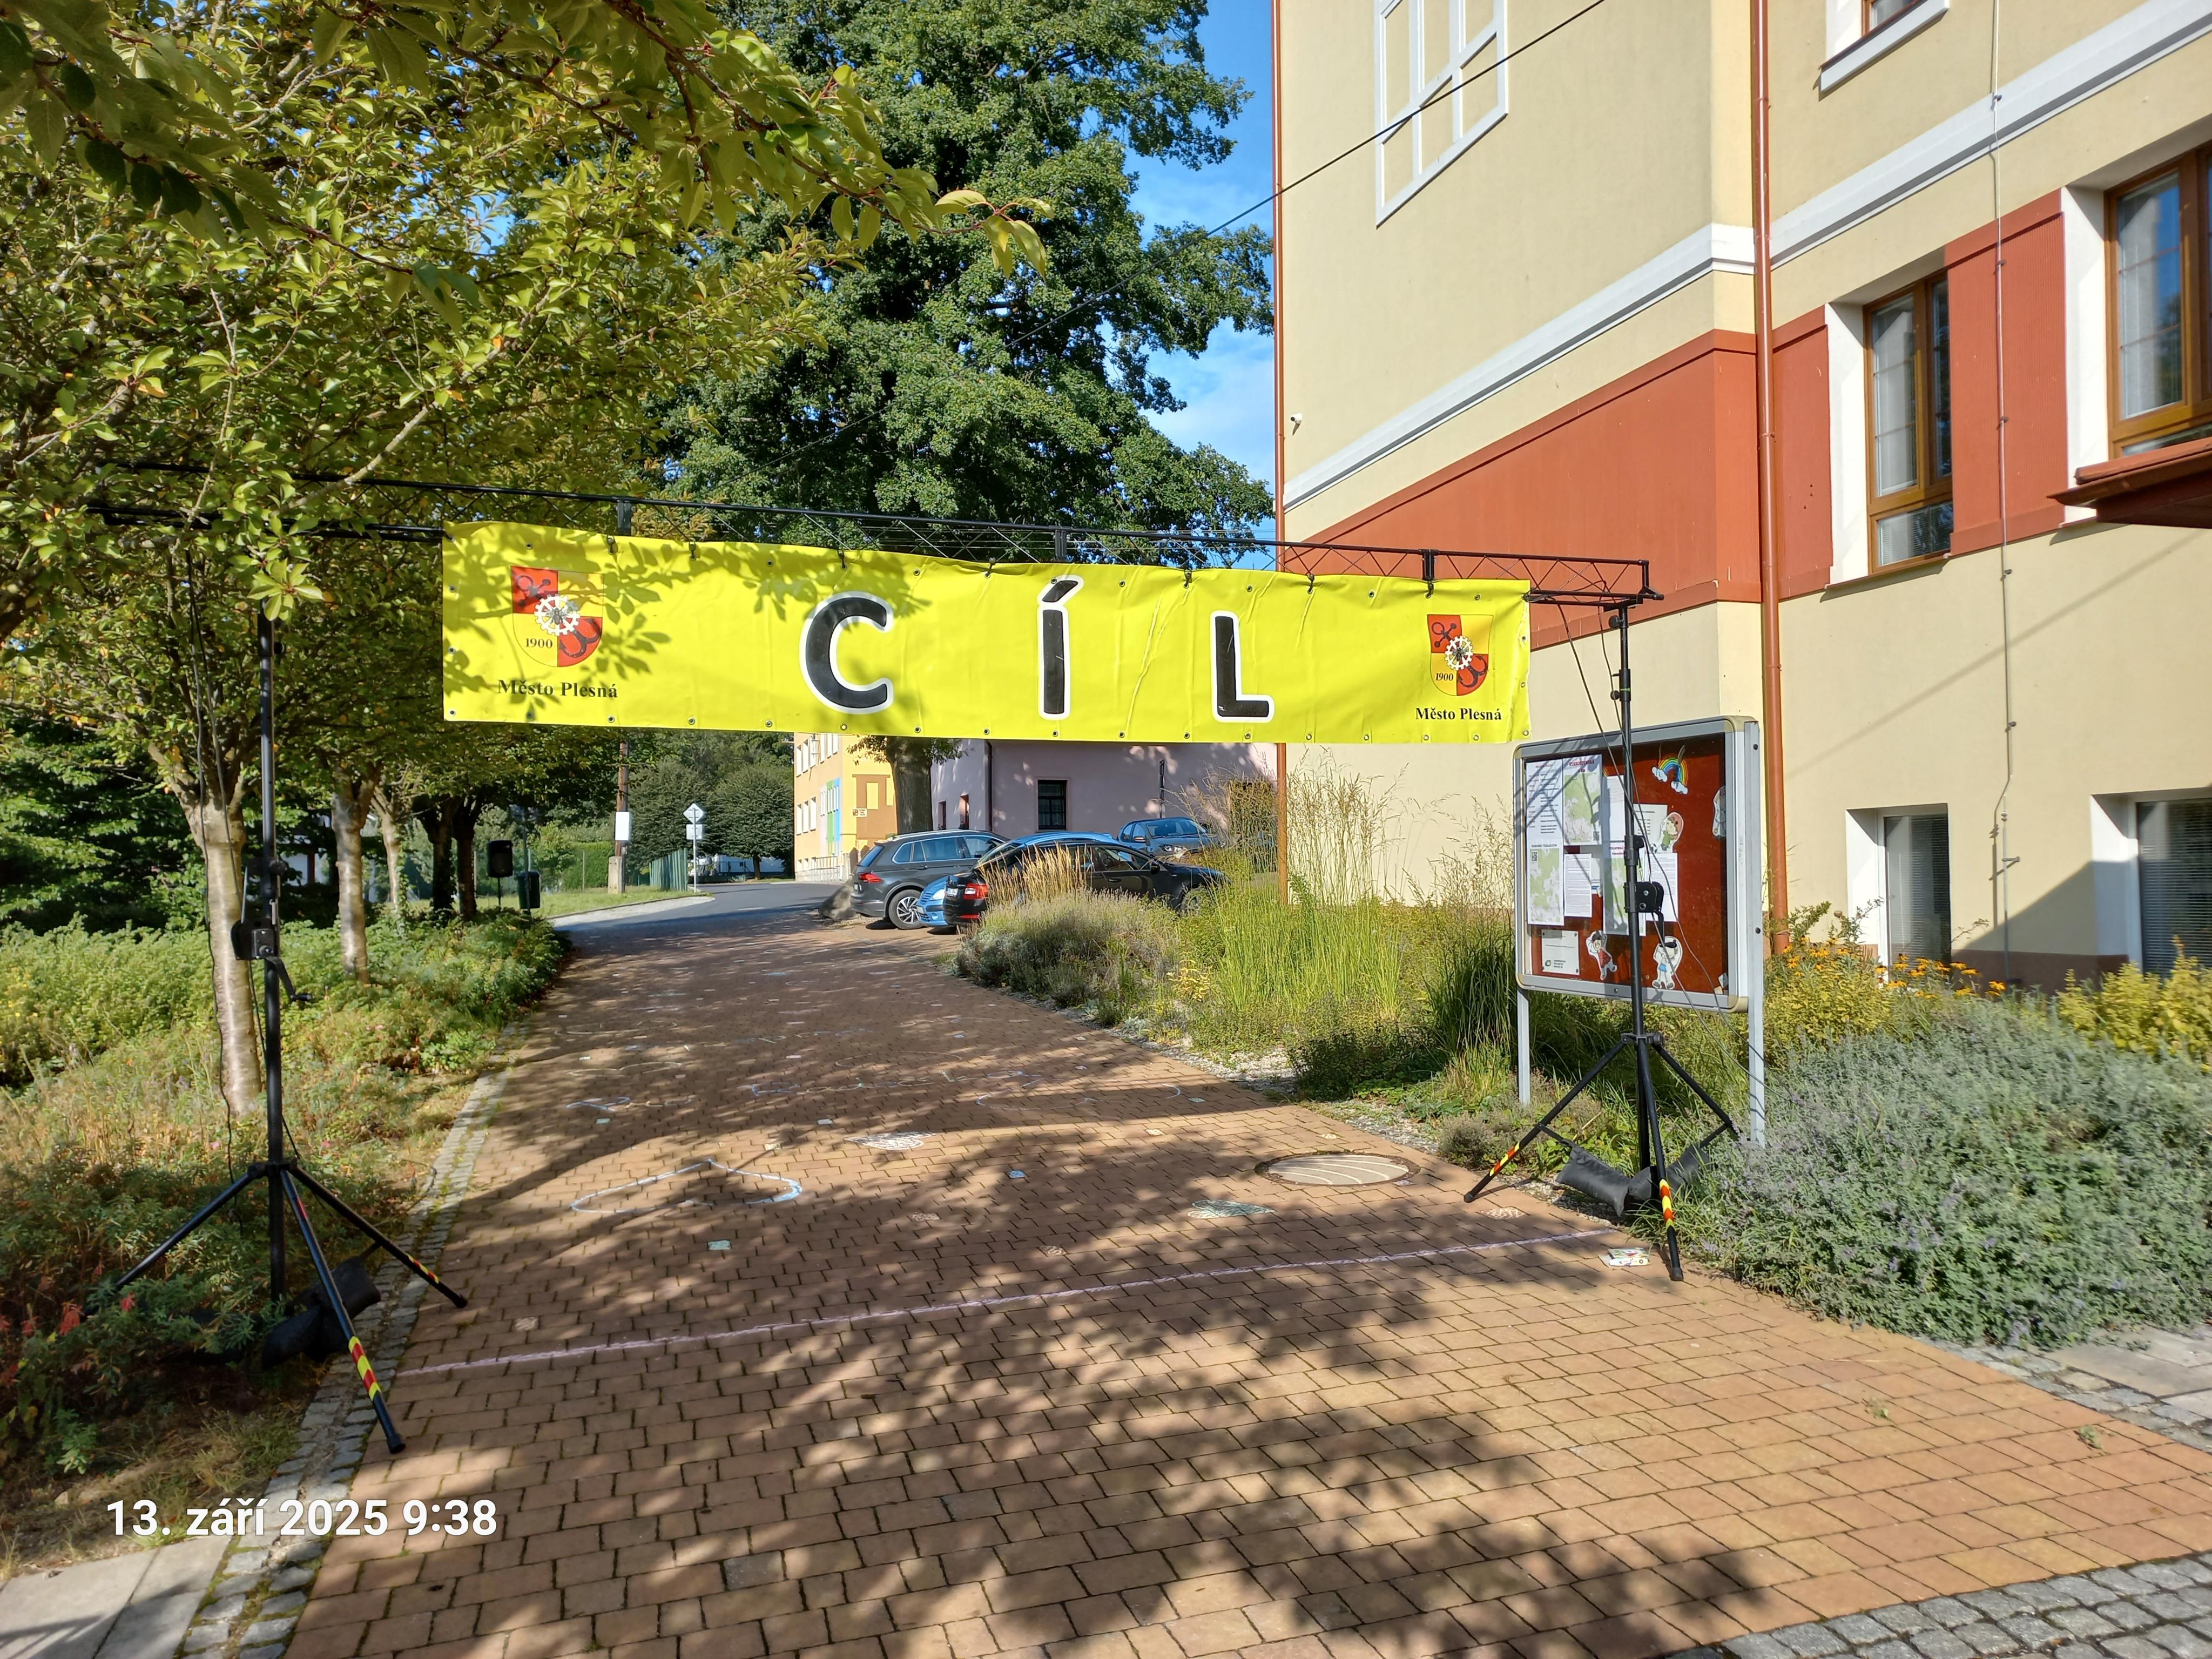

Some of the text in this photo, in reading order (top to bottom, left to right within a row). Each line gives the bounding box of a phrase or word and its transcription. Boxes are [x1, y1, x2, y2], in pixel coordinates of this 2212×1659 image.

[525, 638, 553, 649] 1900
[1435, 673, 1454, 681] 1900
[498, 679, 618, 698] Město Plesná
[1415, 707, 1502, 720] Město Plesná
